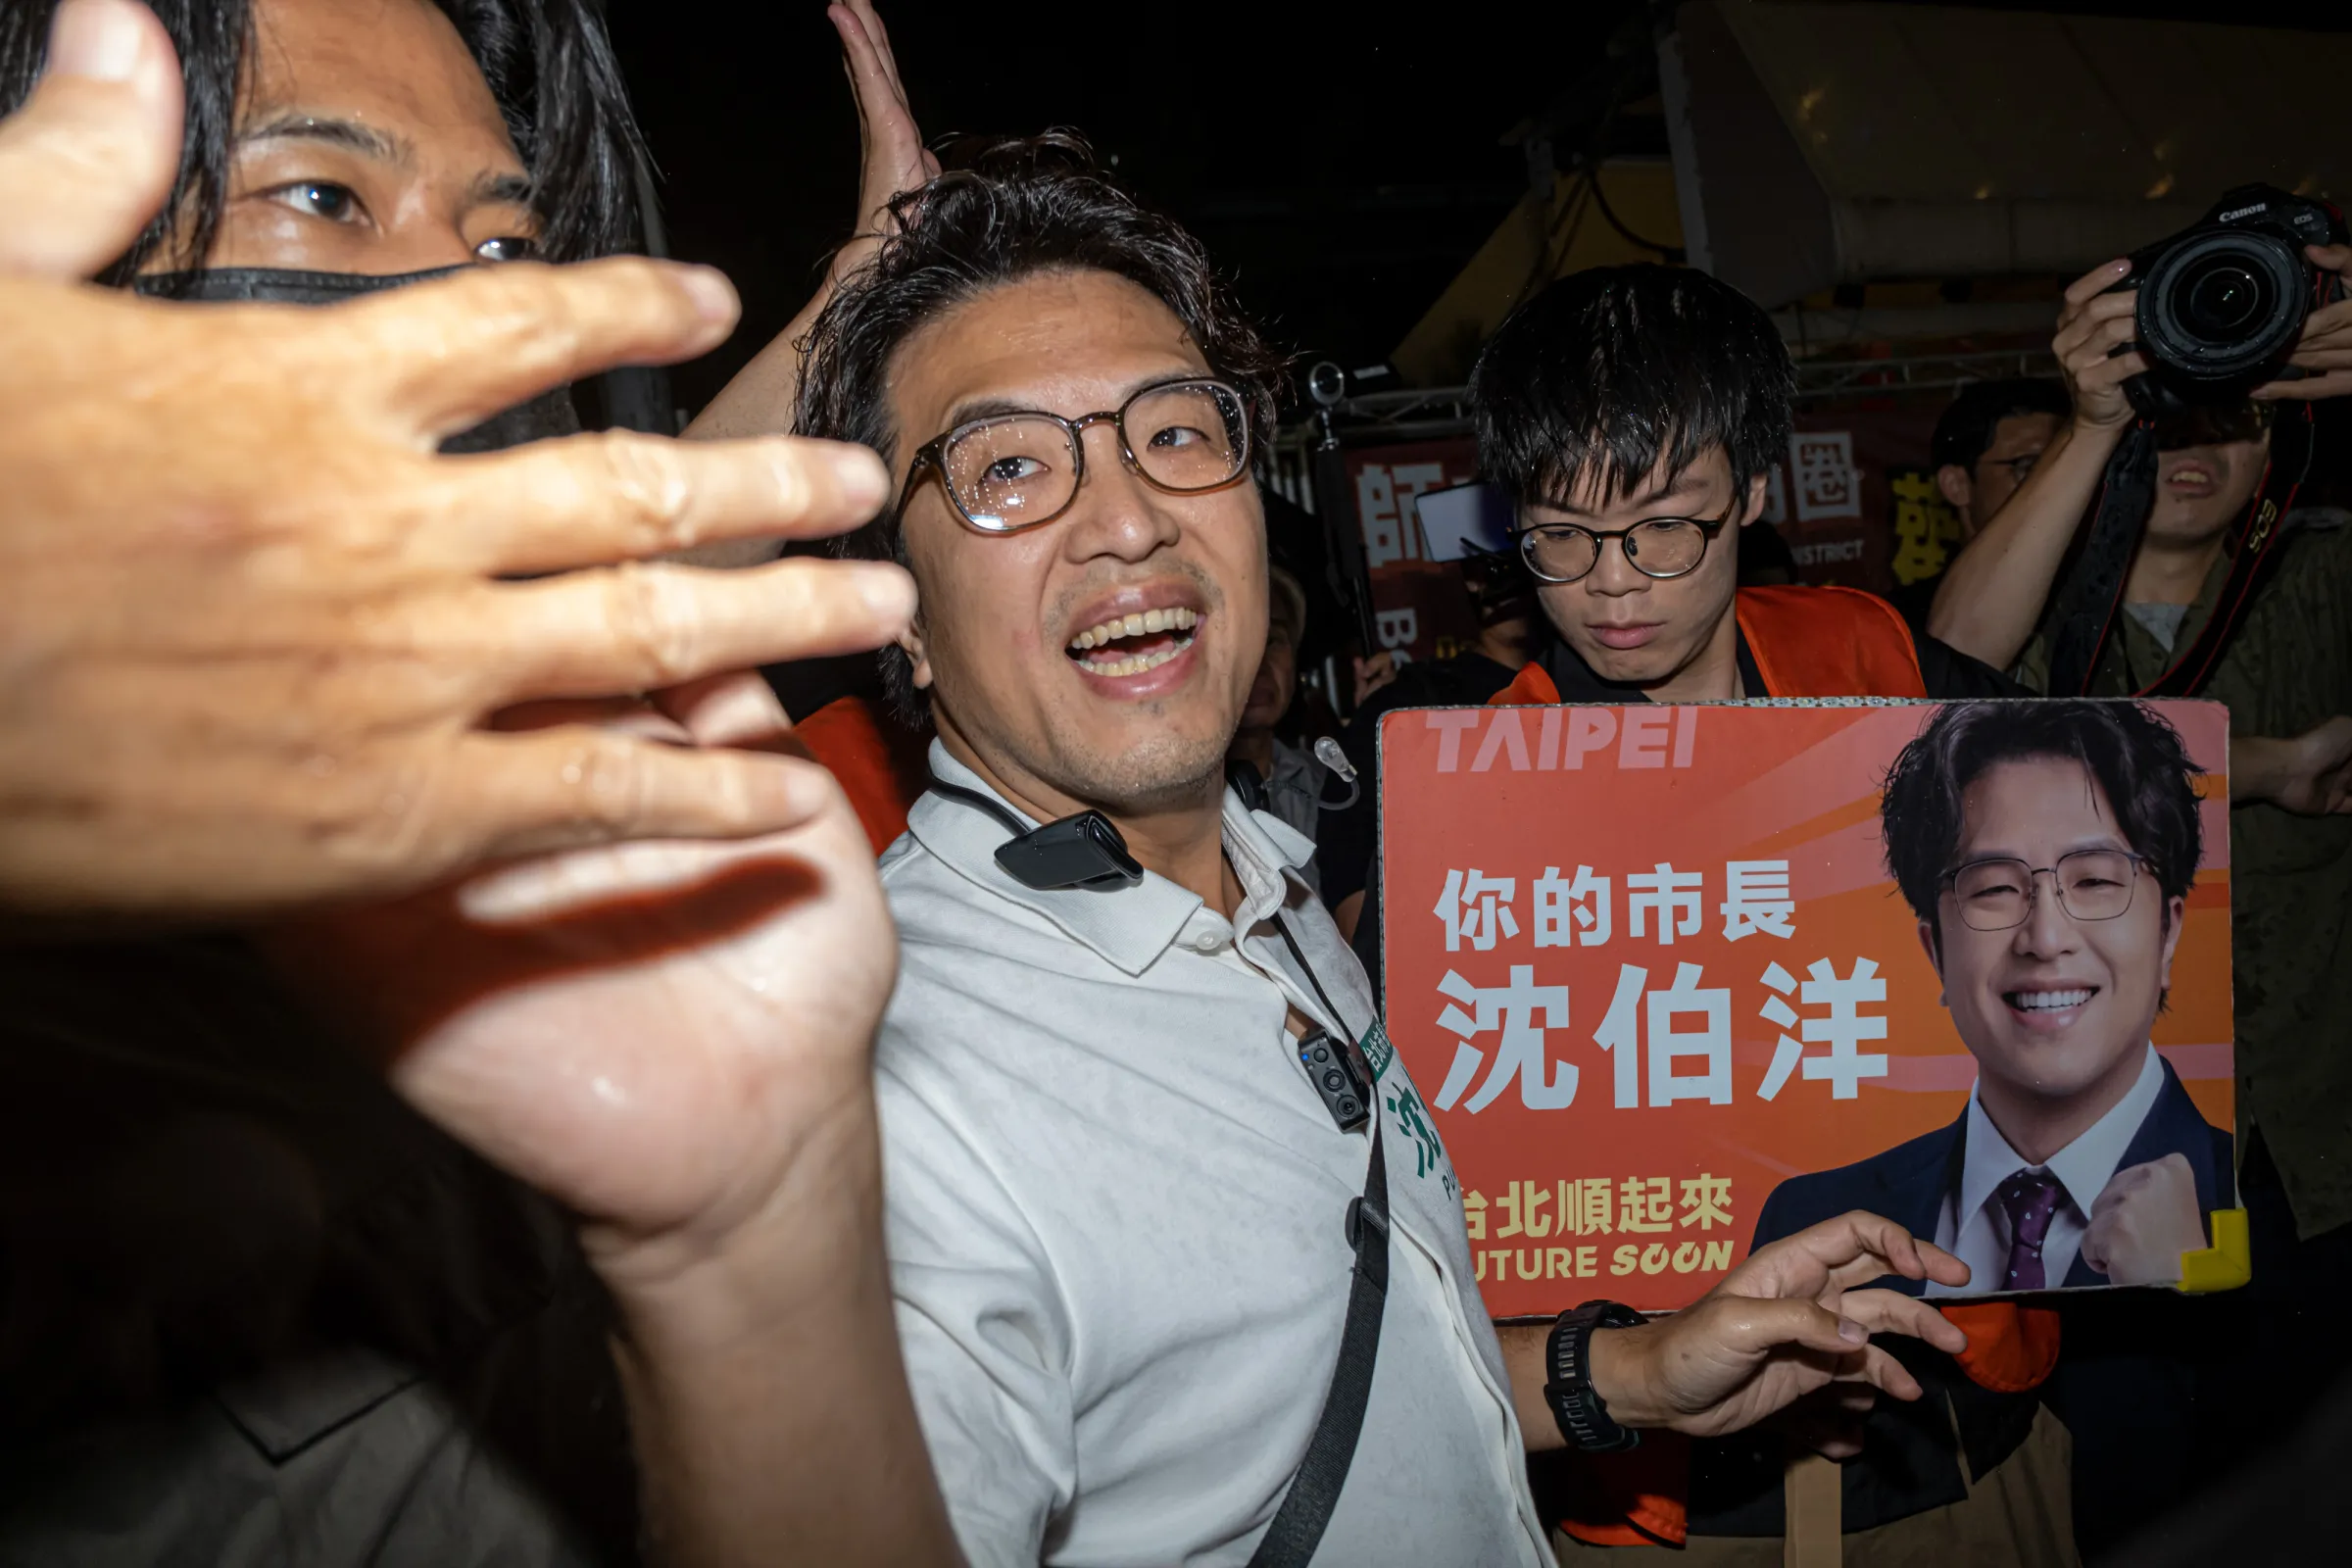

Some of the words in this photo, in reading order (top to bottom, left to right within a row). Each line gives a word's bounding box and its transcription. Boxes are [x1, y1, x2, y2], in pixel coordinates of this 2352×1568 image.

[2219, 202, 2267, 223] Canon
[2293, 213, 2314, 225] EOS
[2248, 498, 2278, 554] EOS
[1426, 706, 1698, 773] TAIPEI
[1433, 859, 1796, 953] 你的市長
[1433, 956, 1888, 1115] 沈伯洋
[1461, 1172, 1735, 1241] 台北順起來
[1609, 1240, 1735, 1277] SOON
